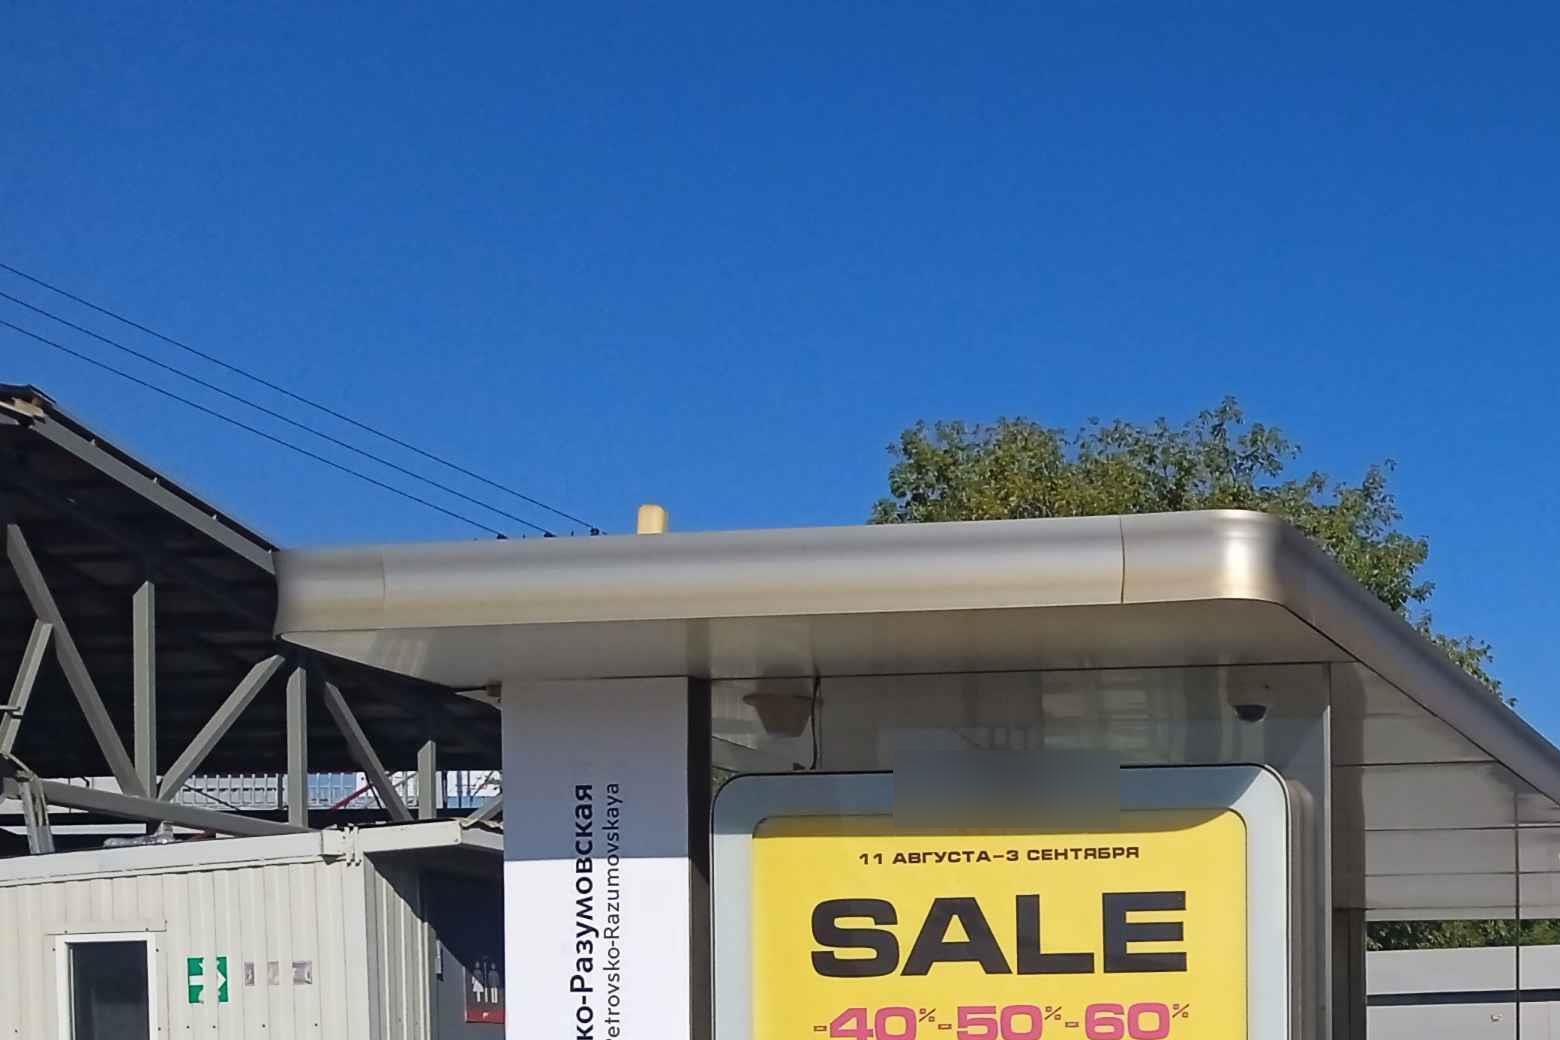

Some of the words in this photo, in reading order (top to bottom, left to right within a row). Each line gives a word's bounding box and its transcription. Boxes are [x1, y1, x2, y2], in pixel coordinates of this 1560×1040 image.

[859, 852, 883, 865] 11
[1026, 846, 1140, 862] СЕНТЯБРЯ
[810, 890, 1188, 979] SALE
